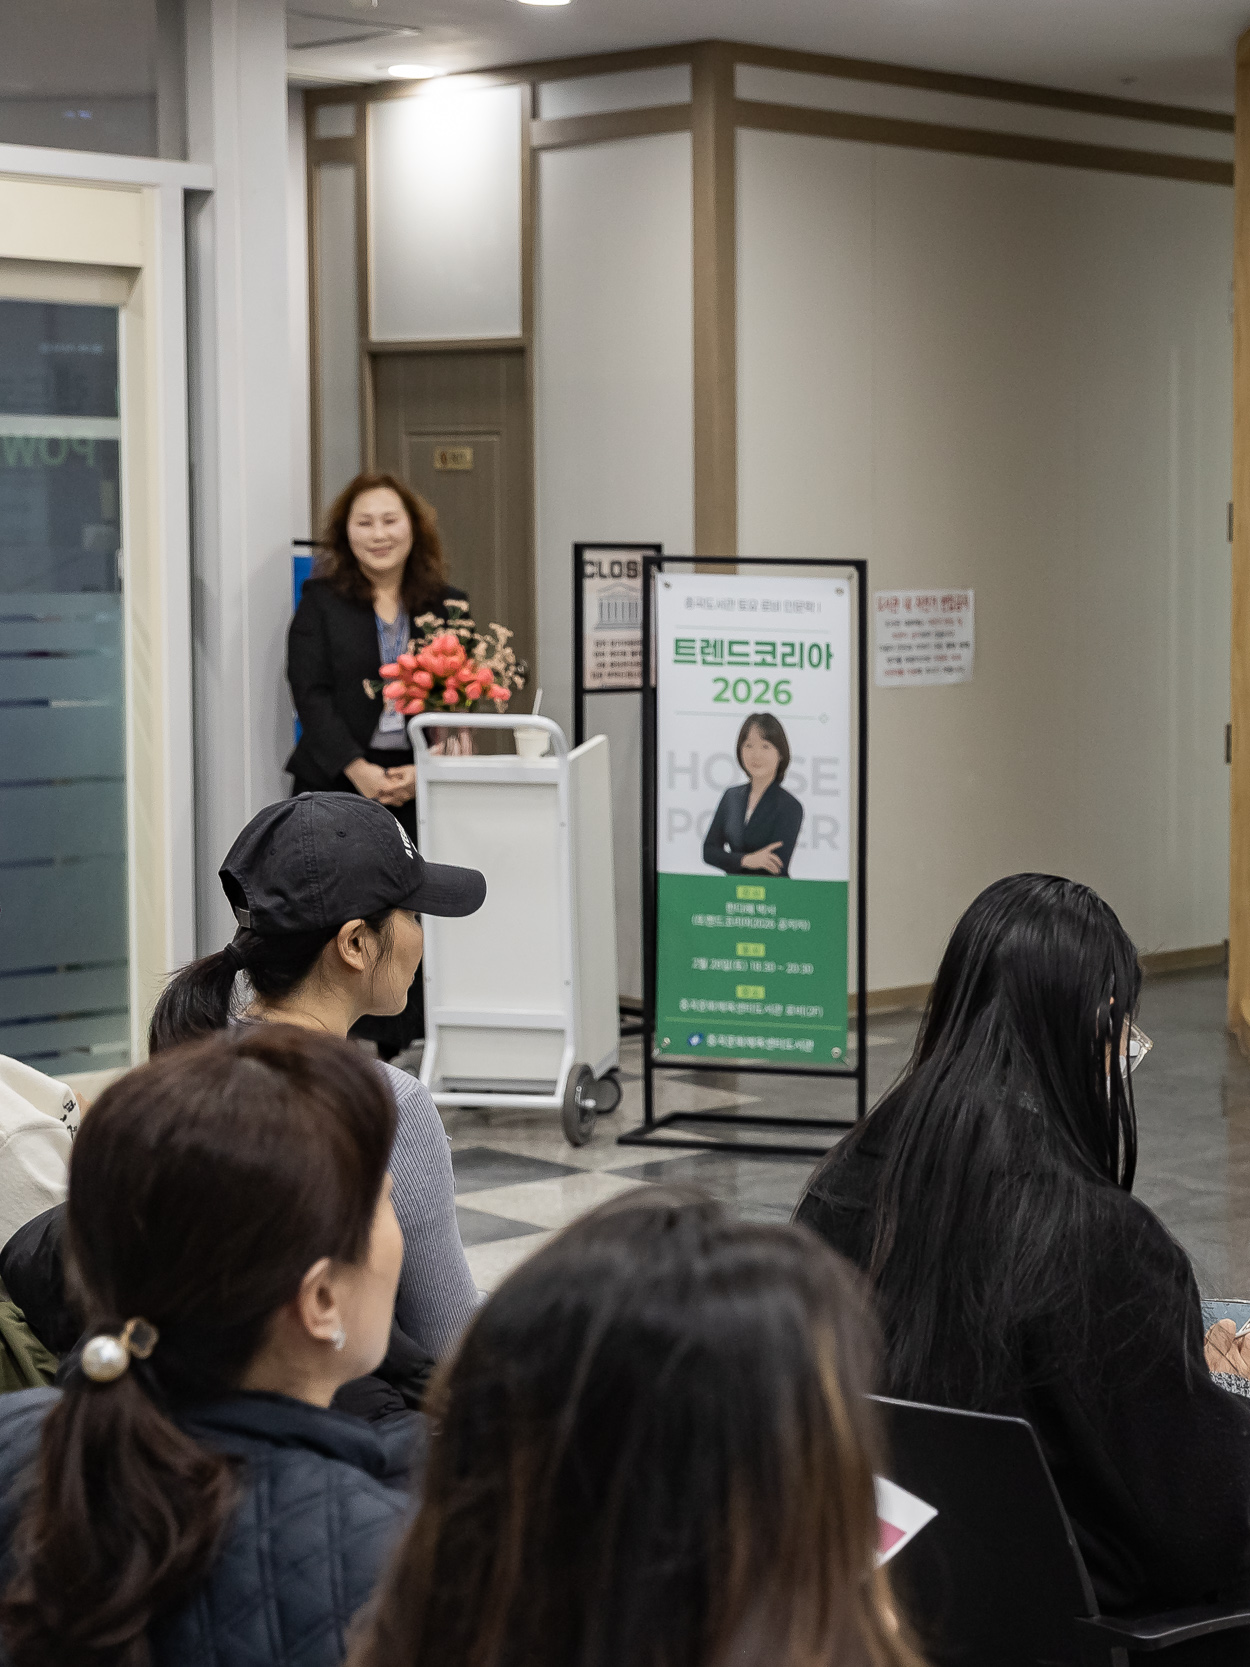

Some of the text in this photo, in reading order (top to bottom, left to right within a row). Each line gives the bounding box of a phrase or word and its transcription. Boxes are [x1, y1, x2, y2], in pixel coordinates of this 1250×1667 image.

[673, 637, 834, 670] 트렌드코리아
[712, 677, 793, 705] 2026
[667, 750, 840, 797] HOSE
